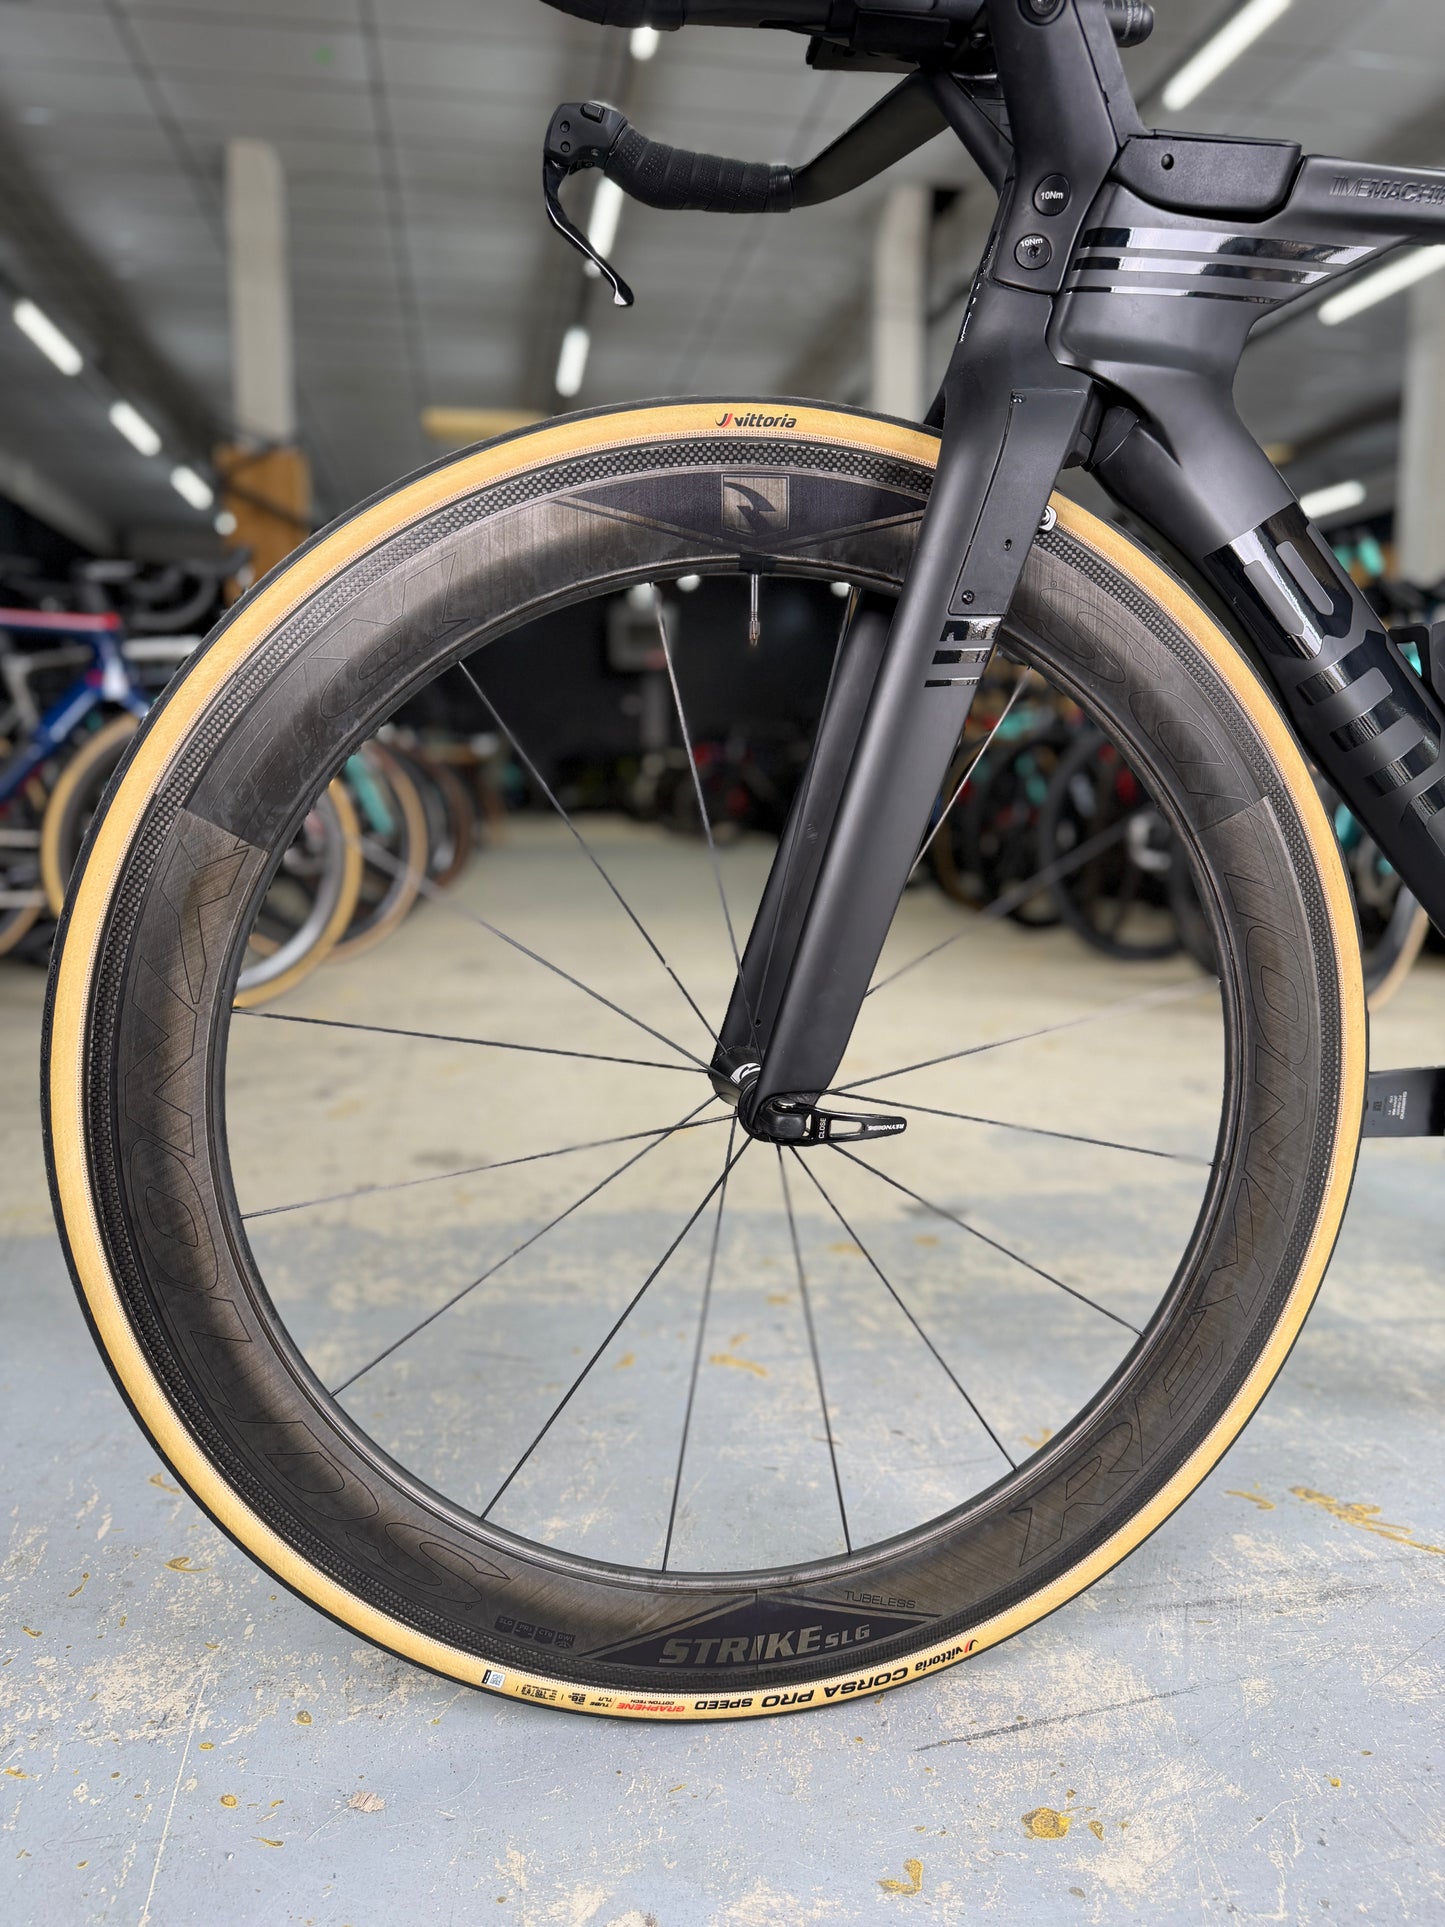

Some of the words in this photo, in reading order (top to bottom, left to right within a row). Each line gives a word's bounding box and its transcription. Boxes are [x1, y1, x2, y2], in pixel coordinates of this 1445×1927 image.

[1040, 190, 1065, 201] 10Nm
[1020, 237, 1044, 248] 10Nm
[734, 412, 798, 429] vittoria
[124, 551, 512, 1606] REYNOLDS
[1010, 587, 1313, 1568] REYNOLDS
[818, 1117, 827, 1139] CLOSE
[844, 1589, 917, 1609] TUBELESS
[659, 1625, 823, 1664] STRIKE
[825, 1624, 871, 1649] SLG
[914, 1646, 964, 1672] vittoria
[823, 1666, 909, 1698] CORSA
[616, 1702, 686, 1713] GRAPHENE
[694, 1697, 753, 1710] SPEED
[761, 1689, 815, 1708] PRO
